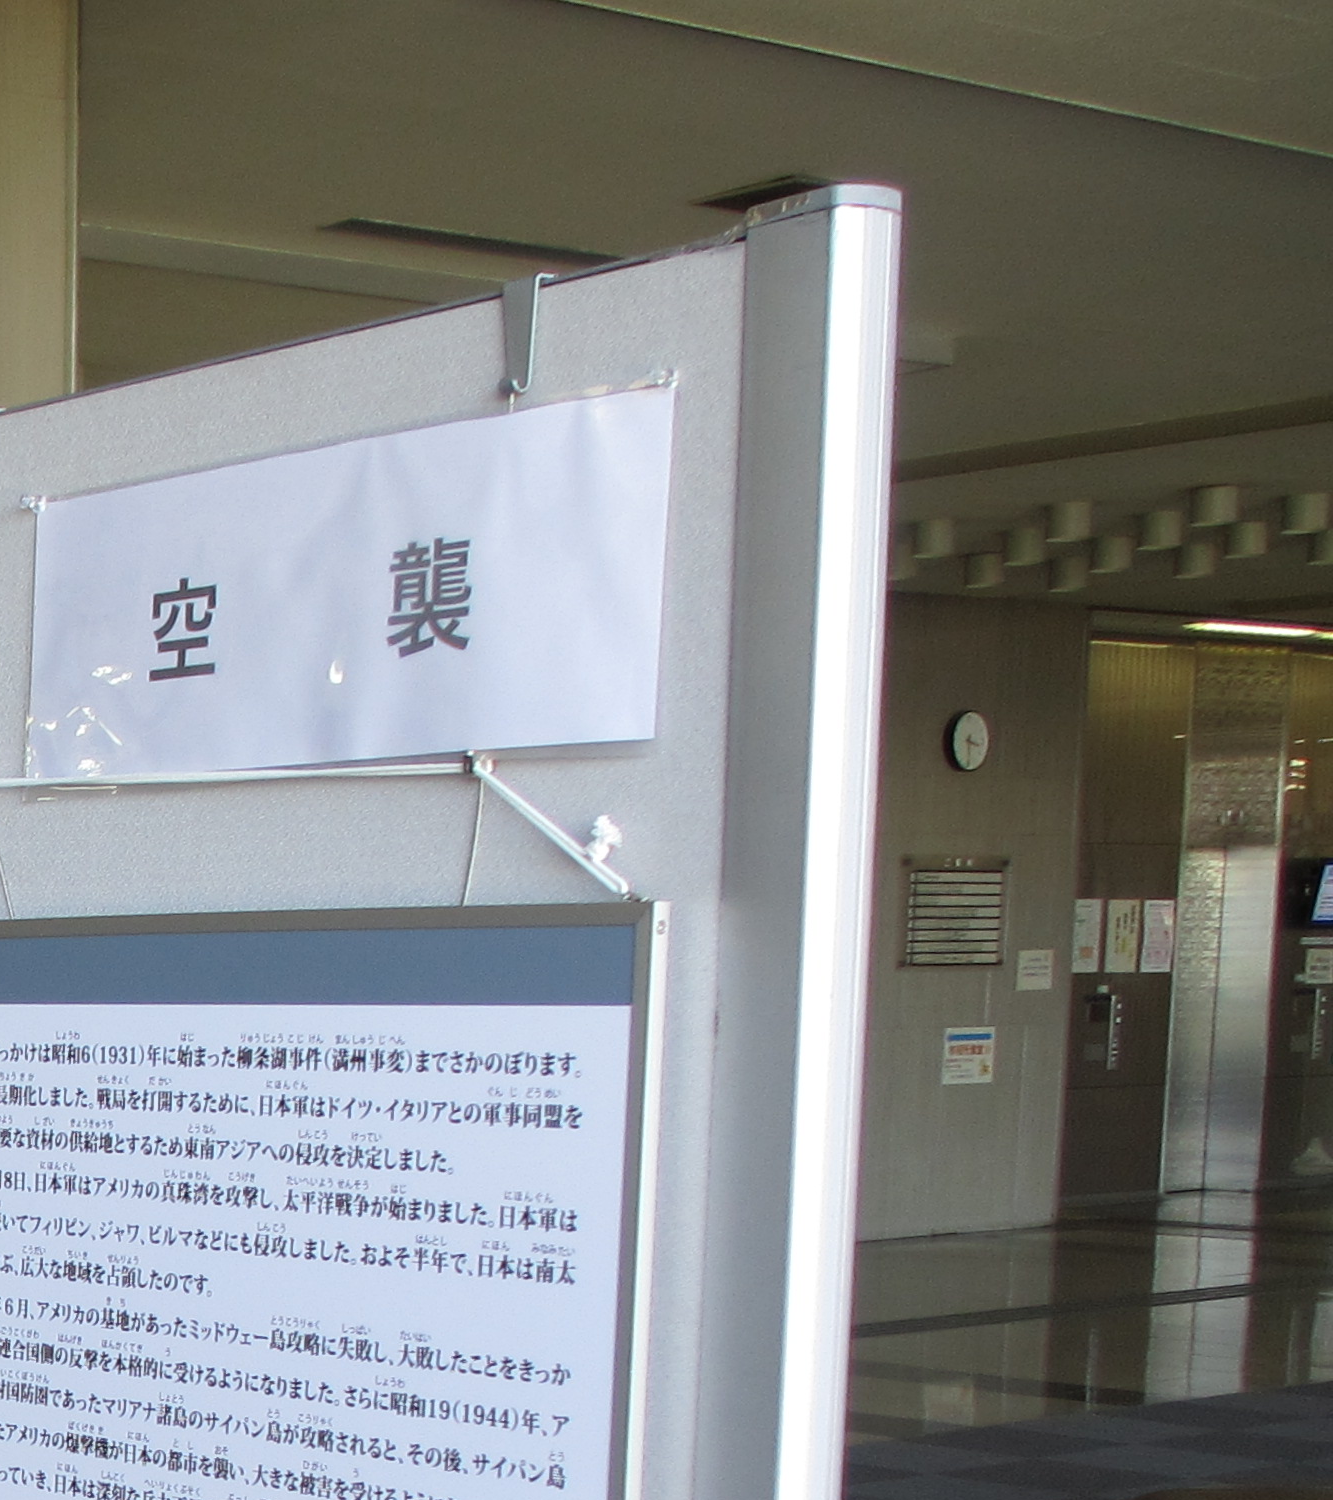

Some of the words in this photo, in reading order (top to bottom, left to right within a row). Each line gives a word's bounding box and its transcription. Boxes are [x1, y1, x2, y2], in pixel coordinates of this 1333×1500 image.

[54, 1029, 82, 1042] しょうわ
[373, 1374, 407, 1390] しょうわ
